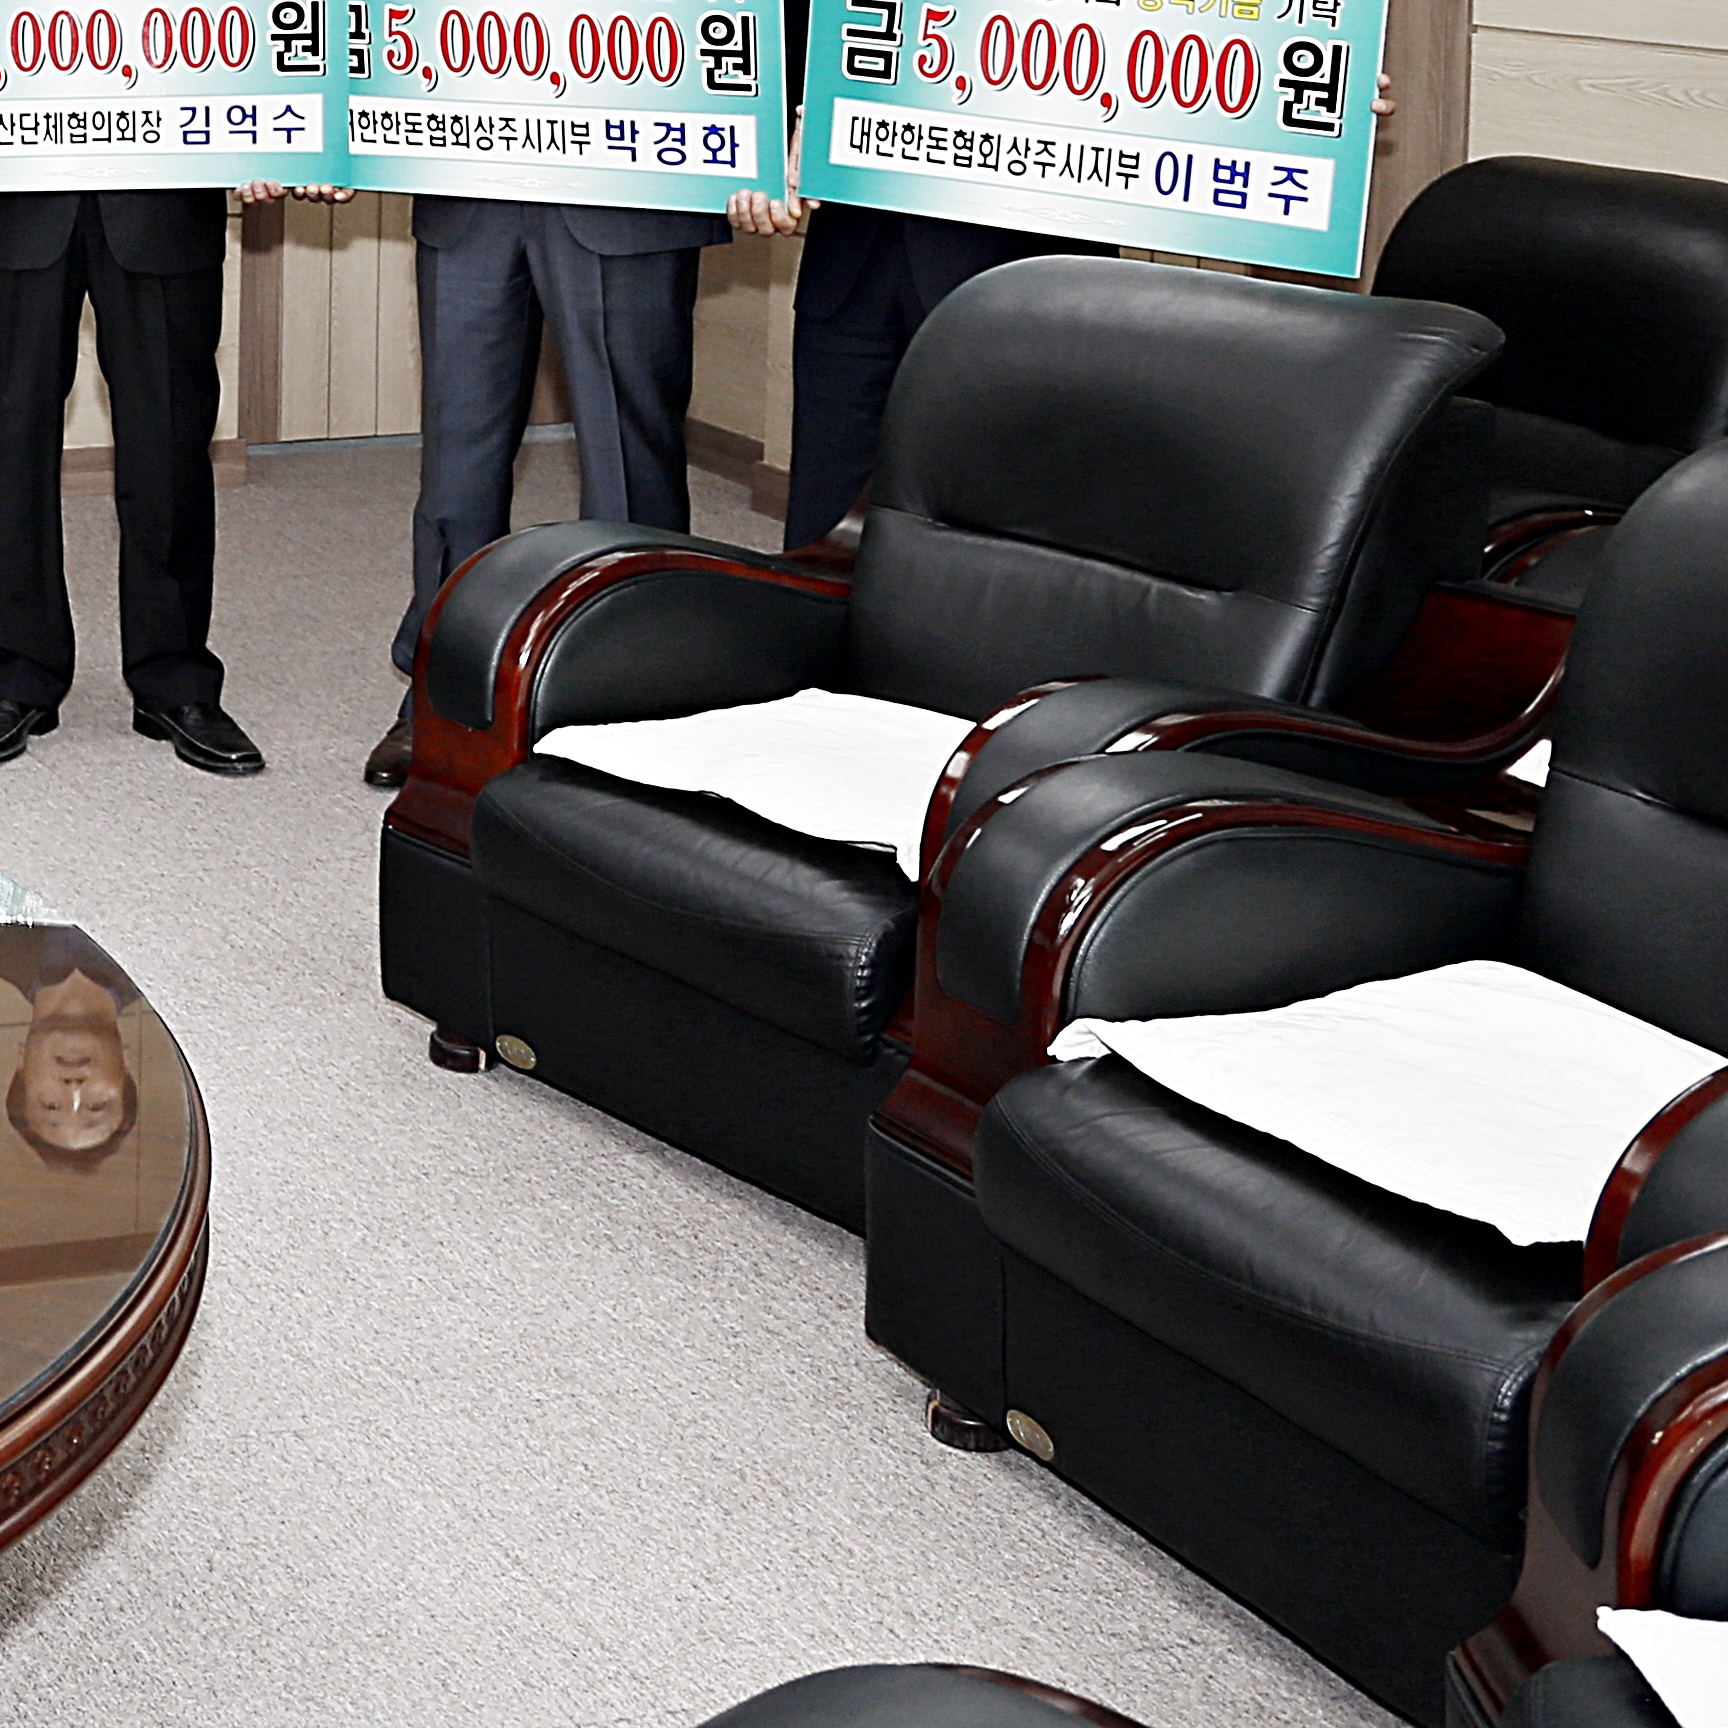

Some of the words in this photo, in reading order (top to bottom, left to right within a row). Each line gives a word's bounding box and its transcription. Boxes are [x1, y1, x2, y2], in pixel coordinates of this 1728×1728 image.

[383, 4, 684, 97] 5,000,000
[697, 12, 758, 96] 원
[913, 4, 1260, 122] 5,000,000
[1276, 40, 1350, 137] 원
[349, 108, 591, 156] 한한돈협회상주시지부
[850, 114, 1141, 191] 대한한돈협회상주시지부
